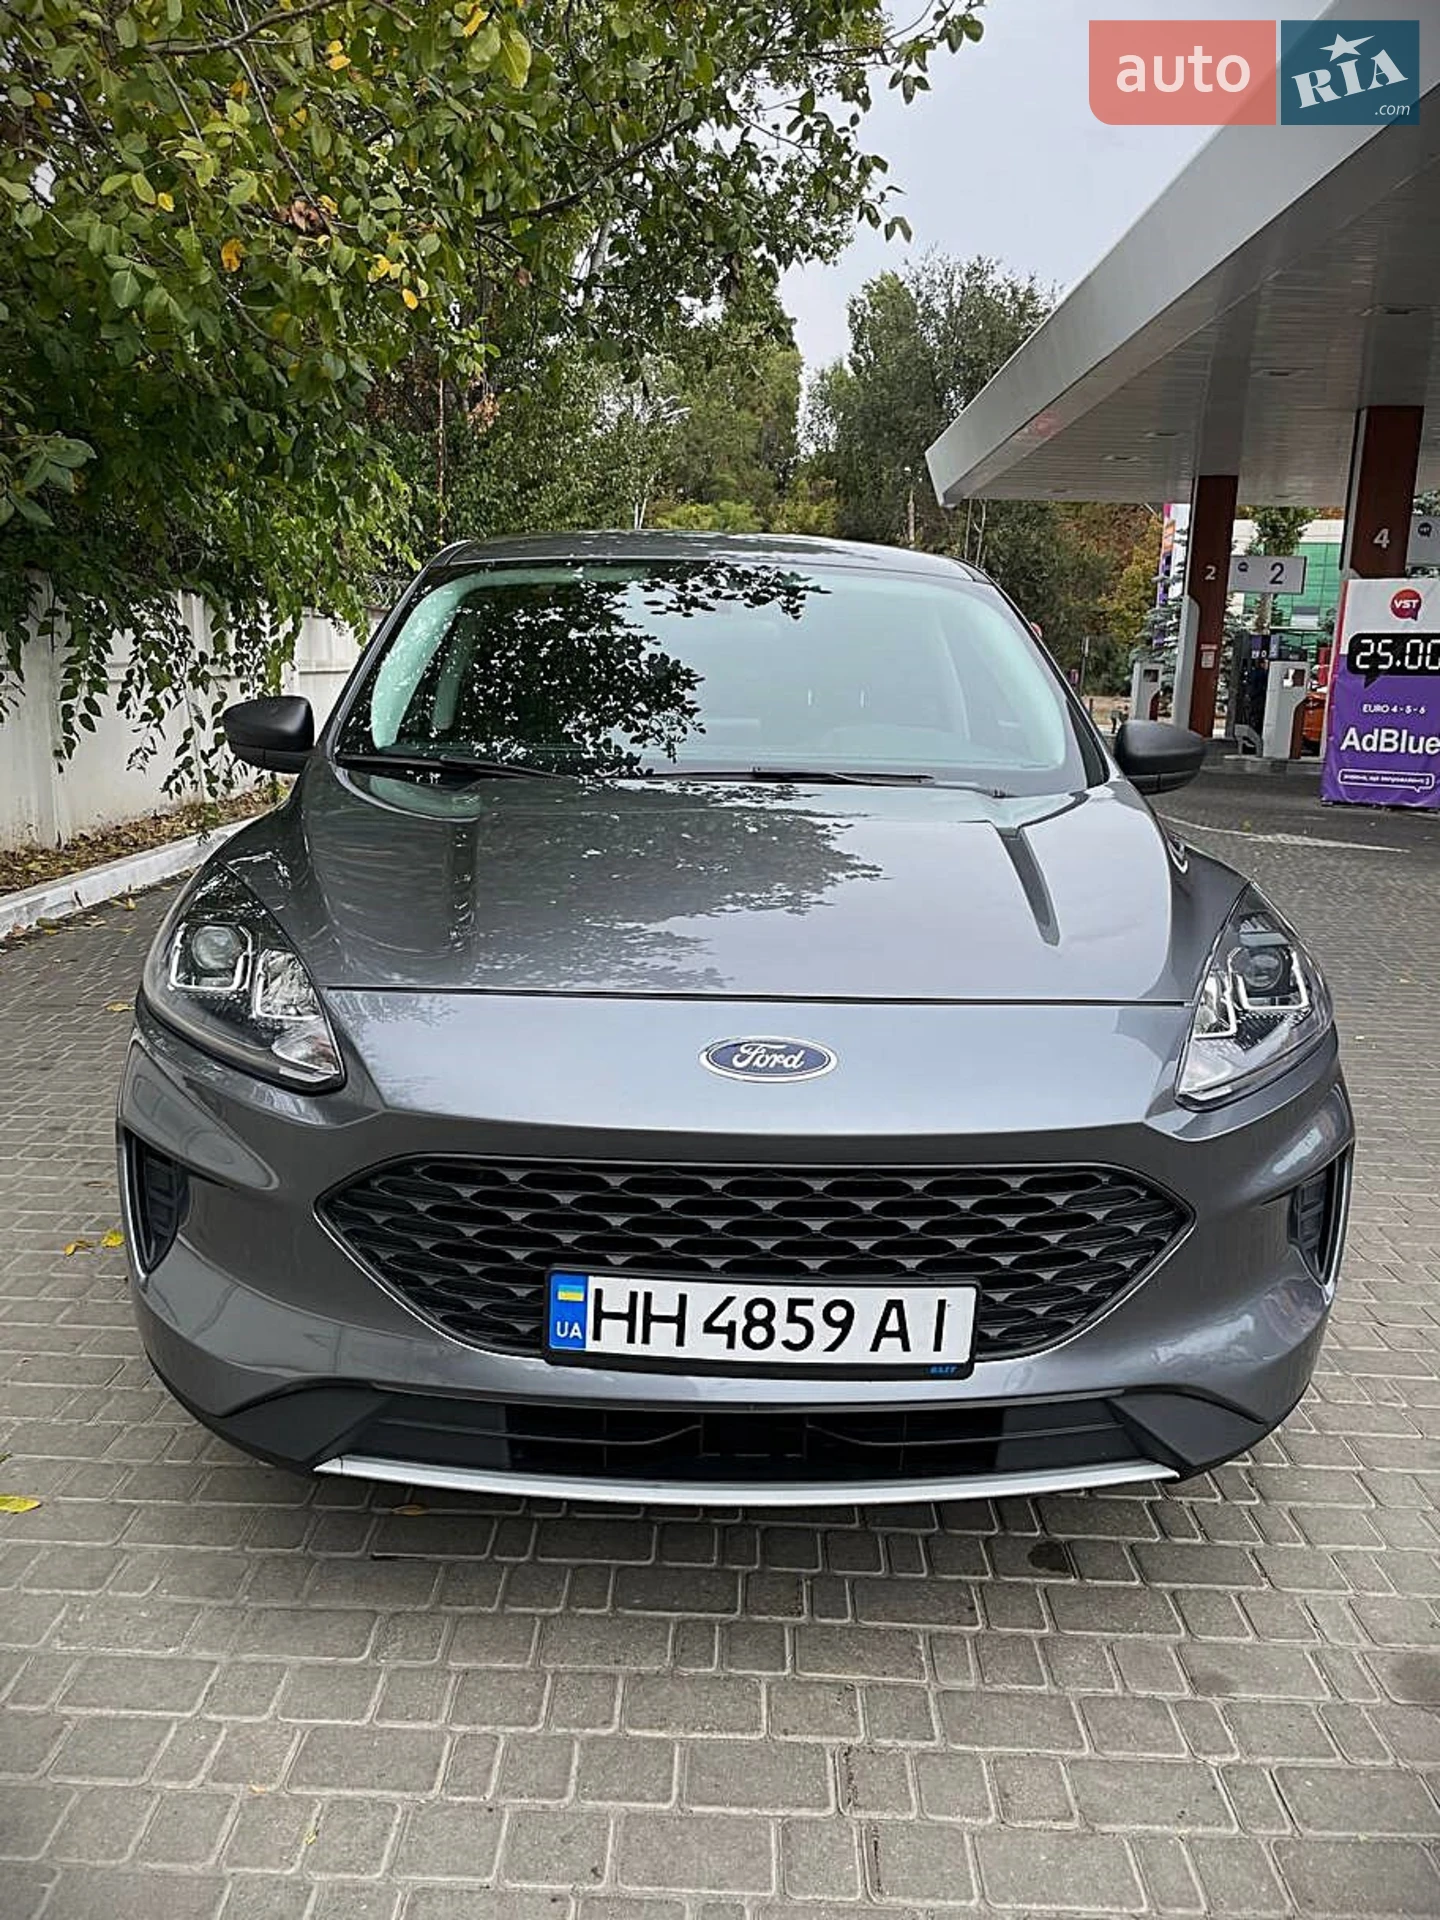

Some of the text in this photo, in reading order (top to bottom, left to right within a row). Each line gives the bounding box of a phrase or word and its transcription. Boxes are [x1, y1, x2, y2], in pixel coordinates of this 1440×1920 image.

[1373, 528, 1390, 548] 4
[1204, 565, 1217, 580] 2
[1269, 562, 1284, 585] 2
[1394, 599, 1419, 609] VST
[1355, 639, 1440, 670] 25.00
[1362, 703, 1390, 713] EURO
[1340, 727, 1440, 755] AdBlue
[732, 1043, 805, 1069] Ford
[556, 1321, 583, 1340] UA
[702, 1295, 856, 1352] 4859
